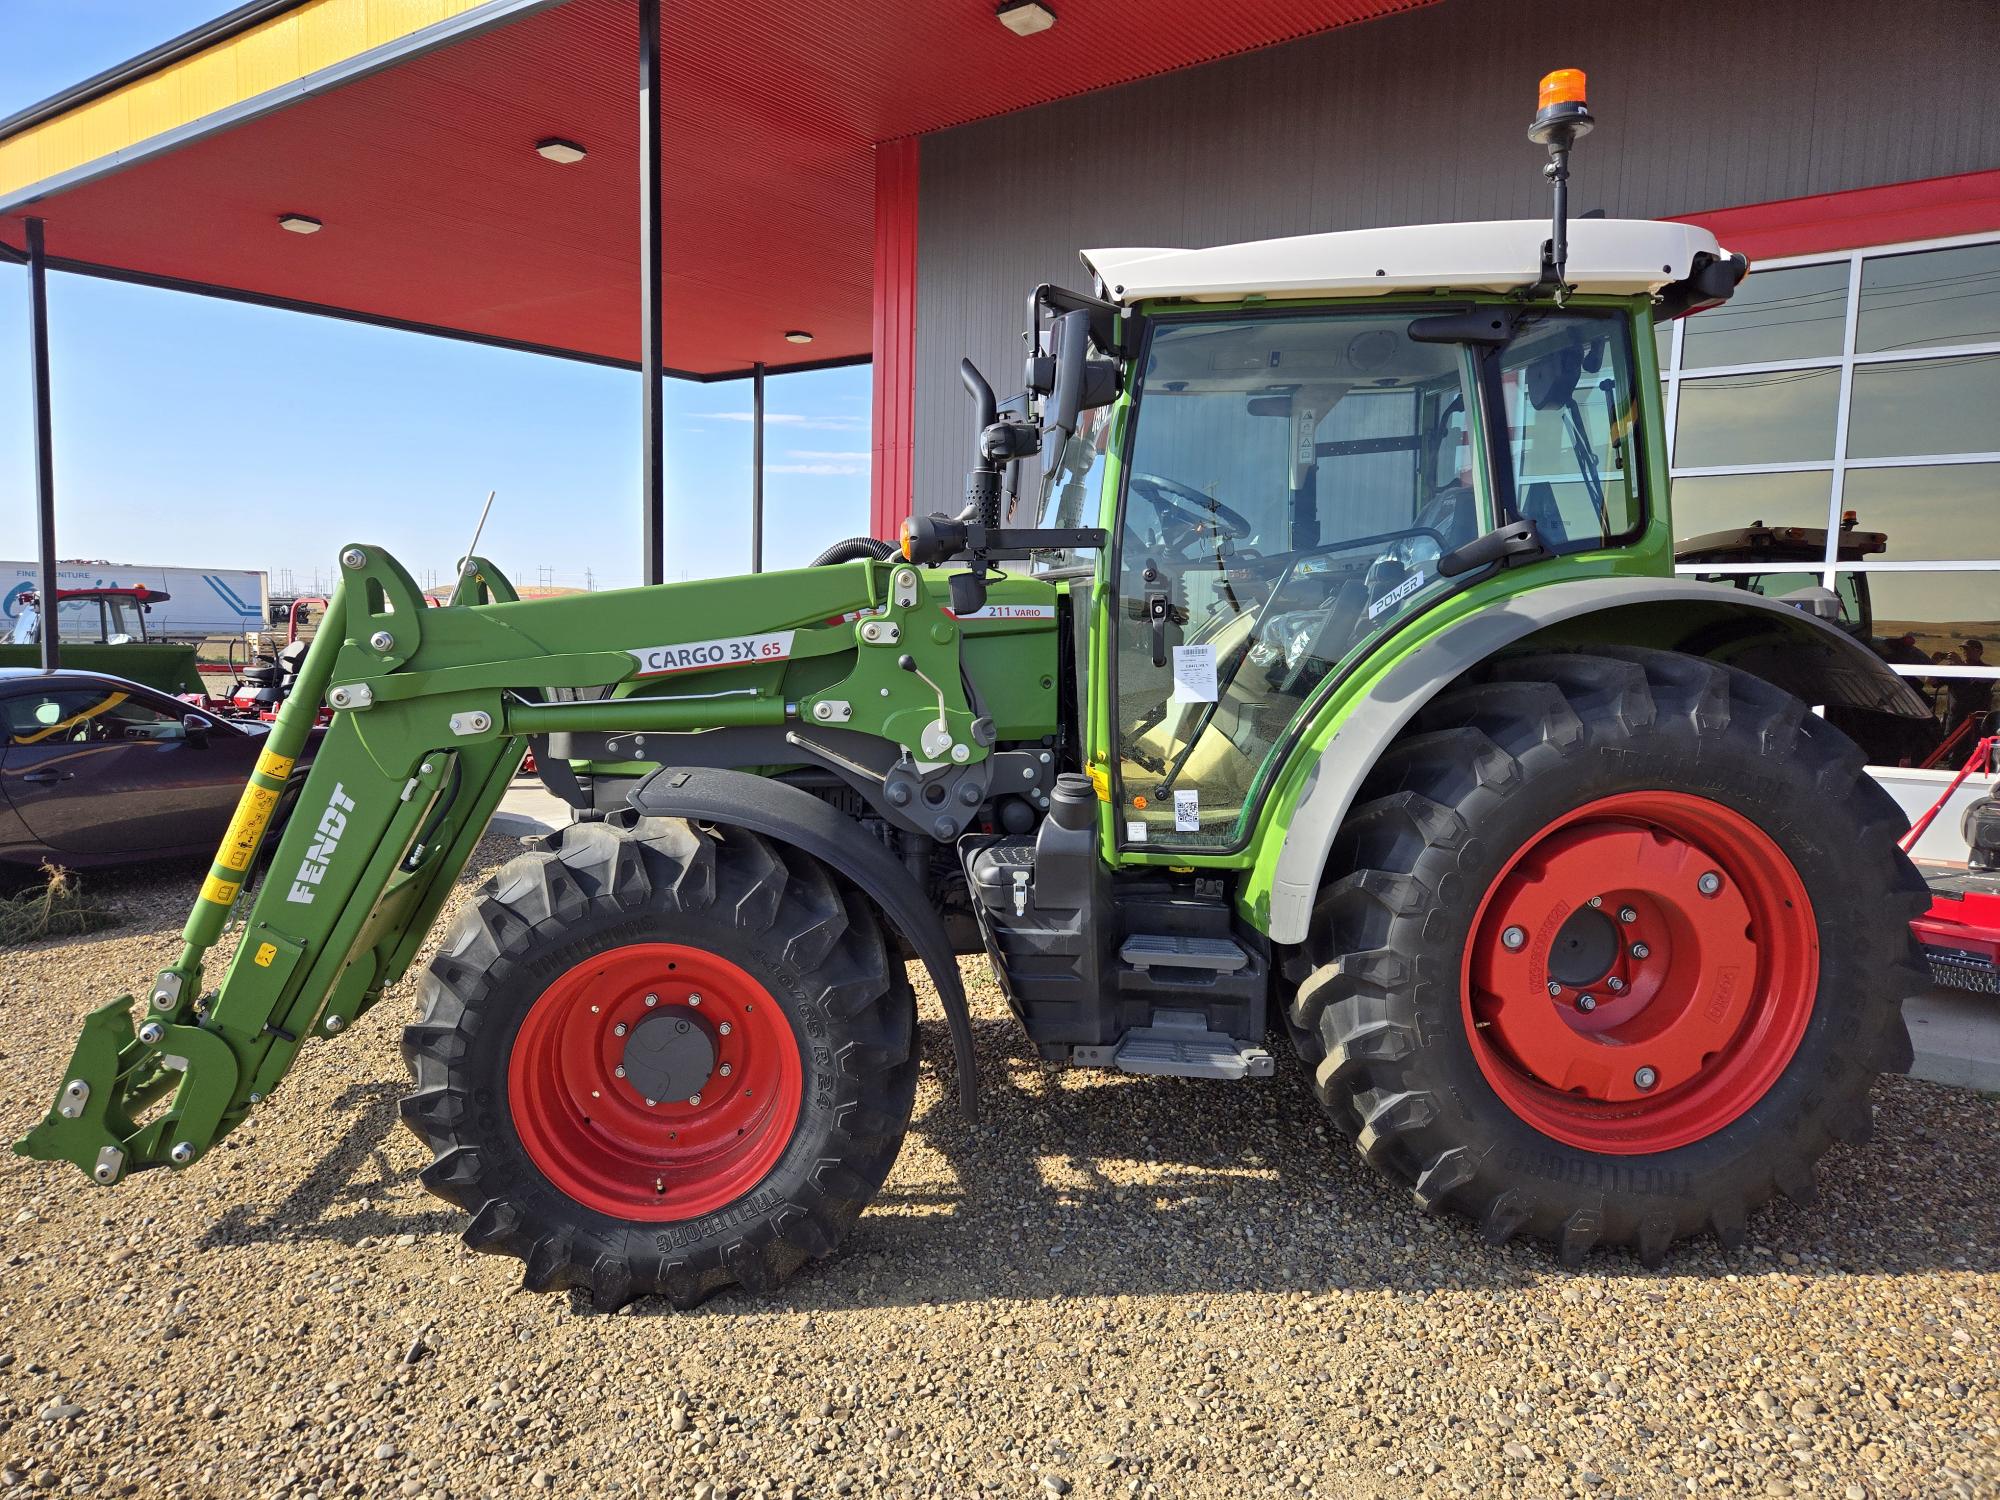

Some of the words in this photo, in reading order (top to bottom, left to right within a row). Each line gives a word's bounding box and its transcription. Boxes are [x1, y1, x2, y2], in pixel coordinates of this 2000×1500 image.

[988, 606, 1011, 618] 211
[1014, 608, 1041, 618] VARIO
[1375, 576, 1419, 613] POWER
[647, 644, 725, 671] CARGO
[729, 640, 758, 661] 3X
[761, 641, 782, 657] 65
[286, 782, 356, 904] FENDT
[816, 1072, 833, 1111] 24
[656, 1187, 785, 1253] TRELLEBORG
